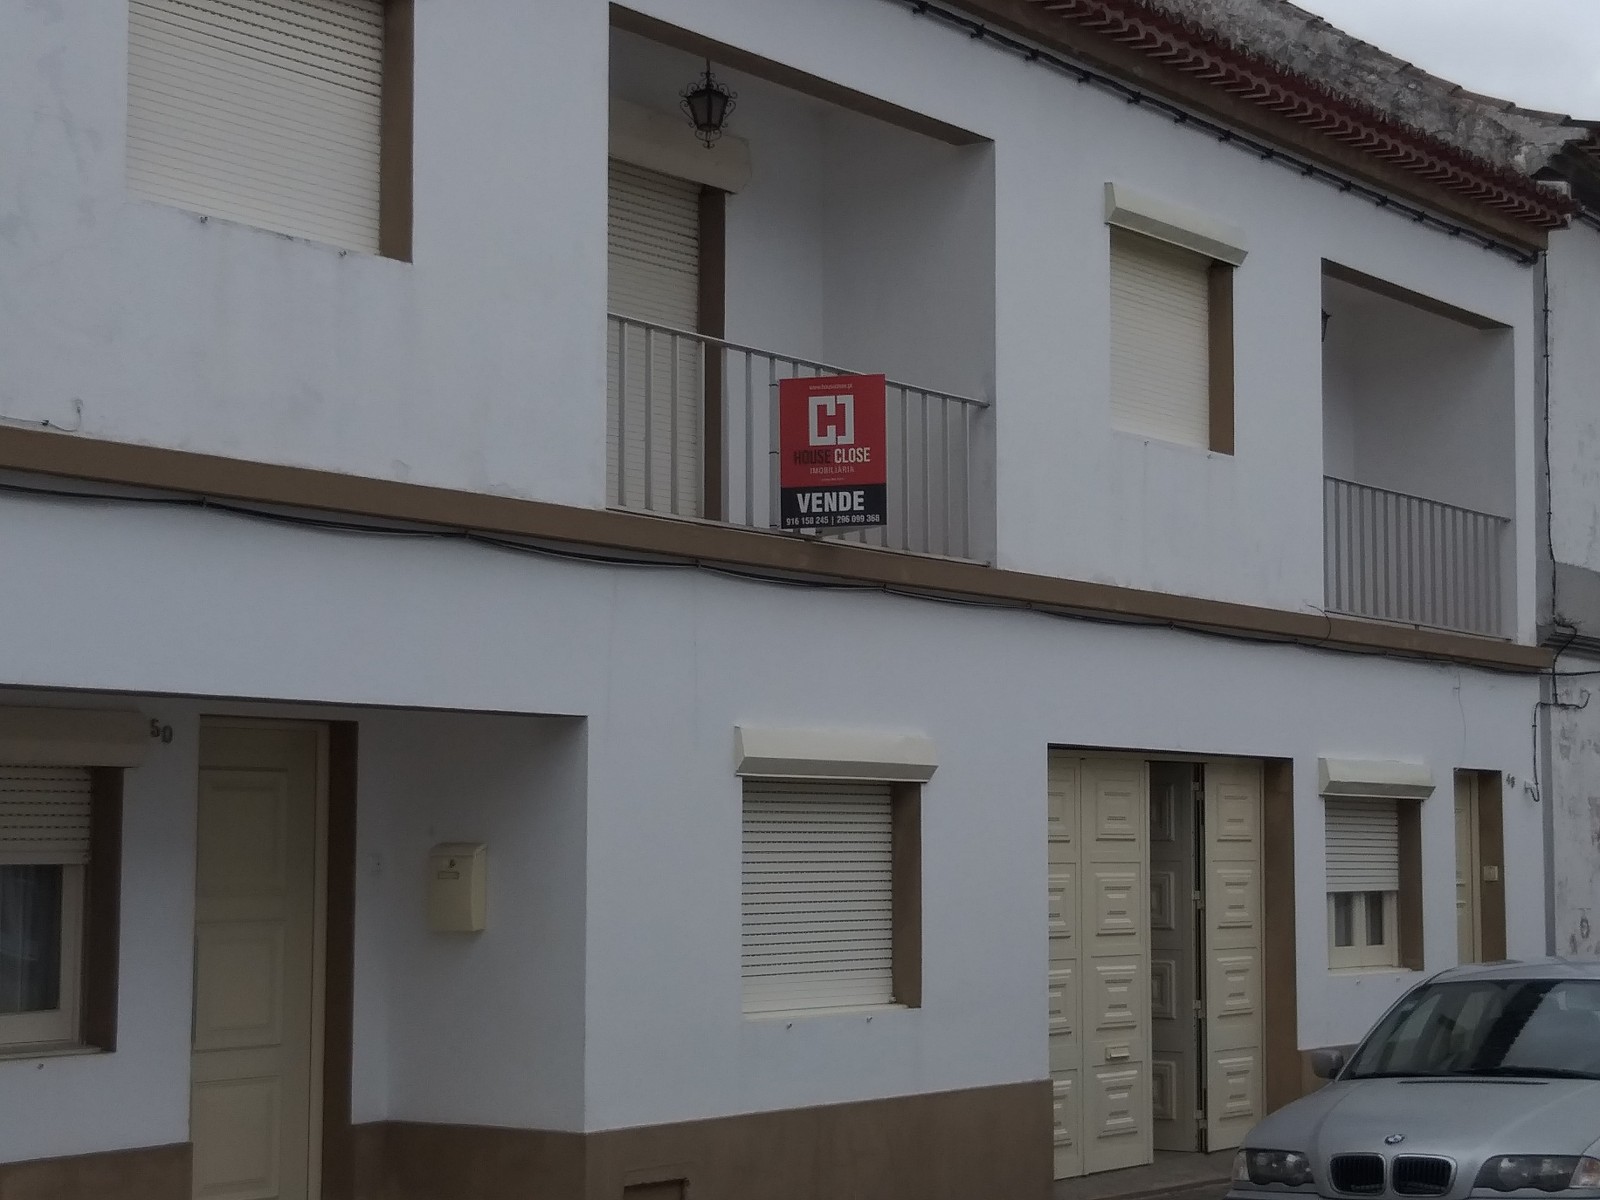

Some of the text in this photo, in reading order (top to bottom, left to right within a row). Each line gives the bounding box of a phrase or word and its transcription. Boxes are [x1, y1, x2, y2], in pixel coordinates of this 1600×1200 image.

[793, 447, 871, 465] HOUSE CLOSE
[797, 491, 865, 513] VENDE
[786, 518, 800, 526] 916
[815, 515, 829, 525] 245
[151, 719, 172, 744] 50
